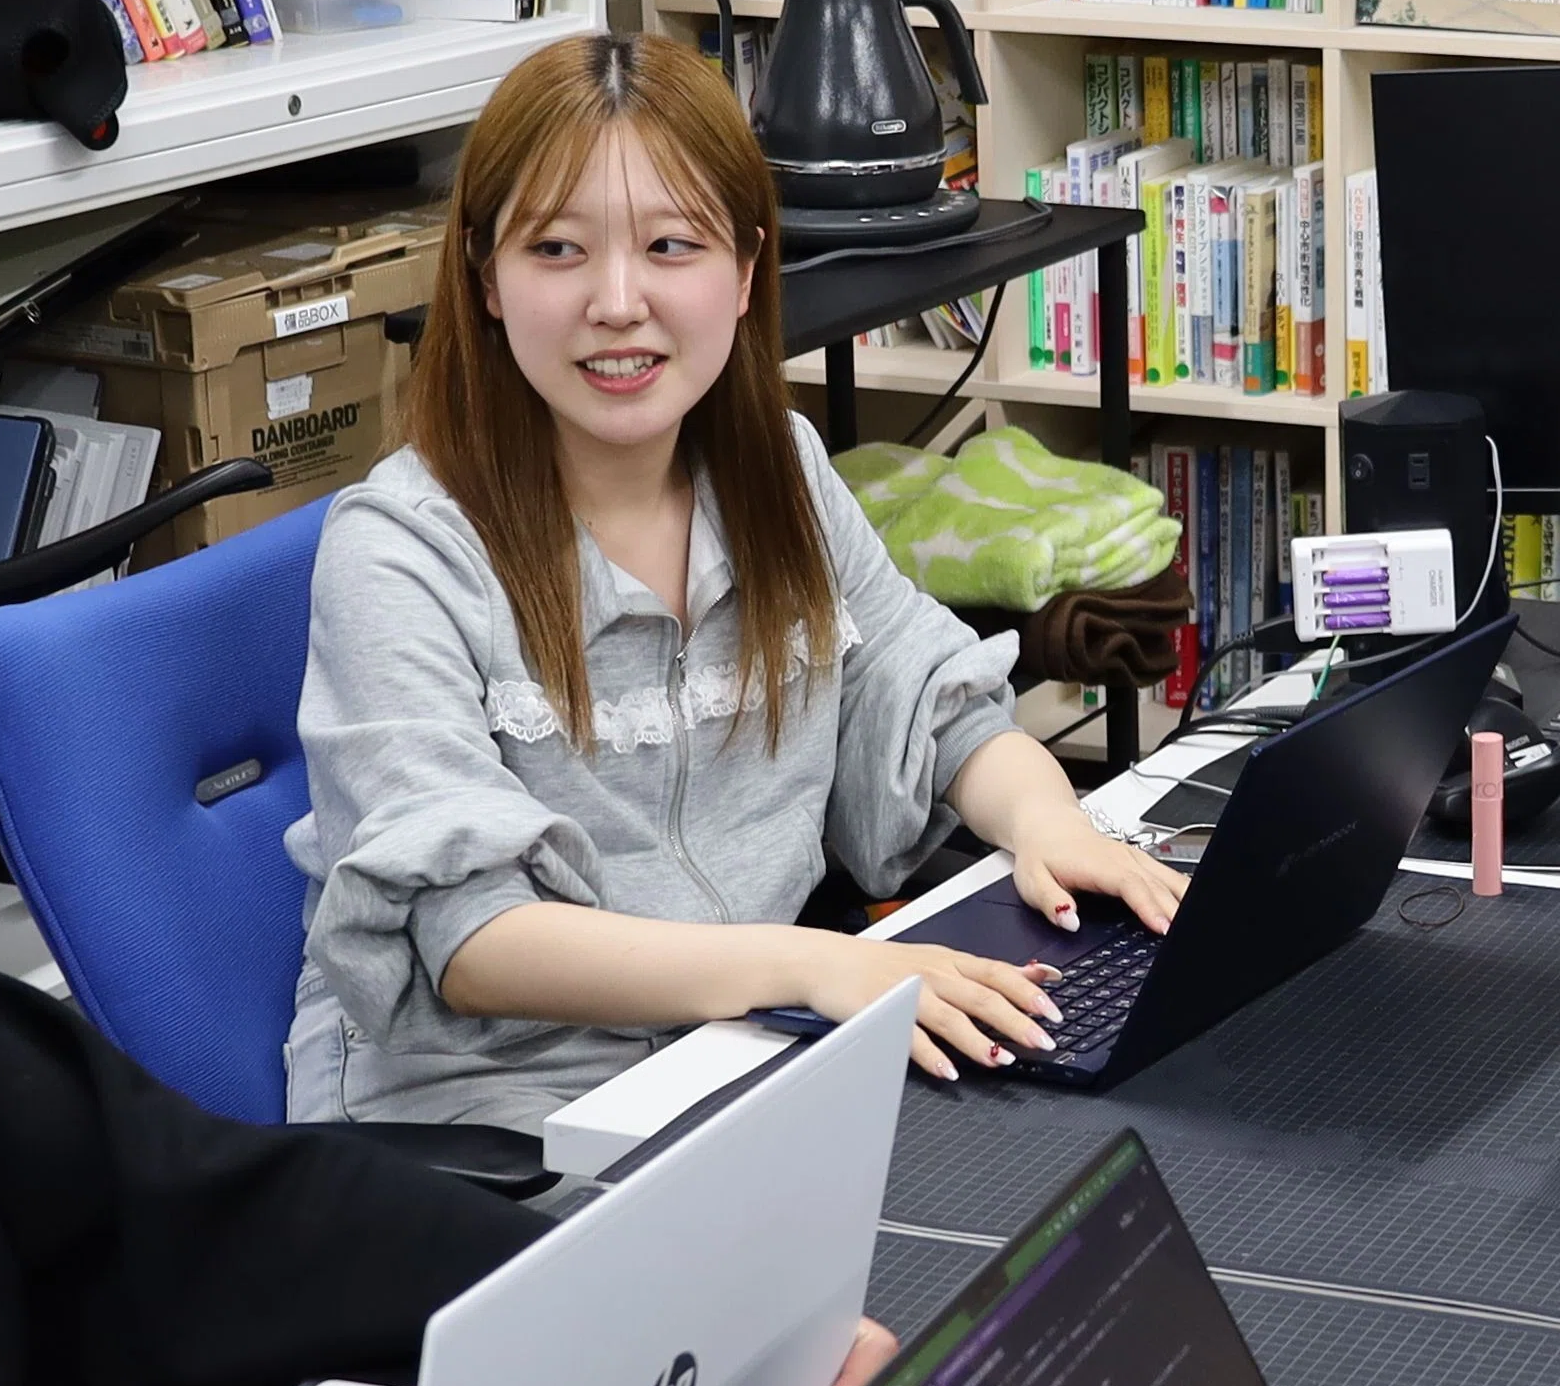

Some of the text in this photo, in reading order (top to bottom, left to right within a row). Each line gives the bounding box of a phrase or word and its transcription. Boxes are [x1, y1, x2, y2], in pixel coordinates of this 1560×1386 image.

[1298, 220, 1312, 308] 中心市街地活性化
[283, 302, 340, 331] 備品BOX
[251, 404, 357, 451] DANBOARD
